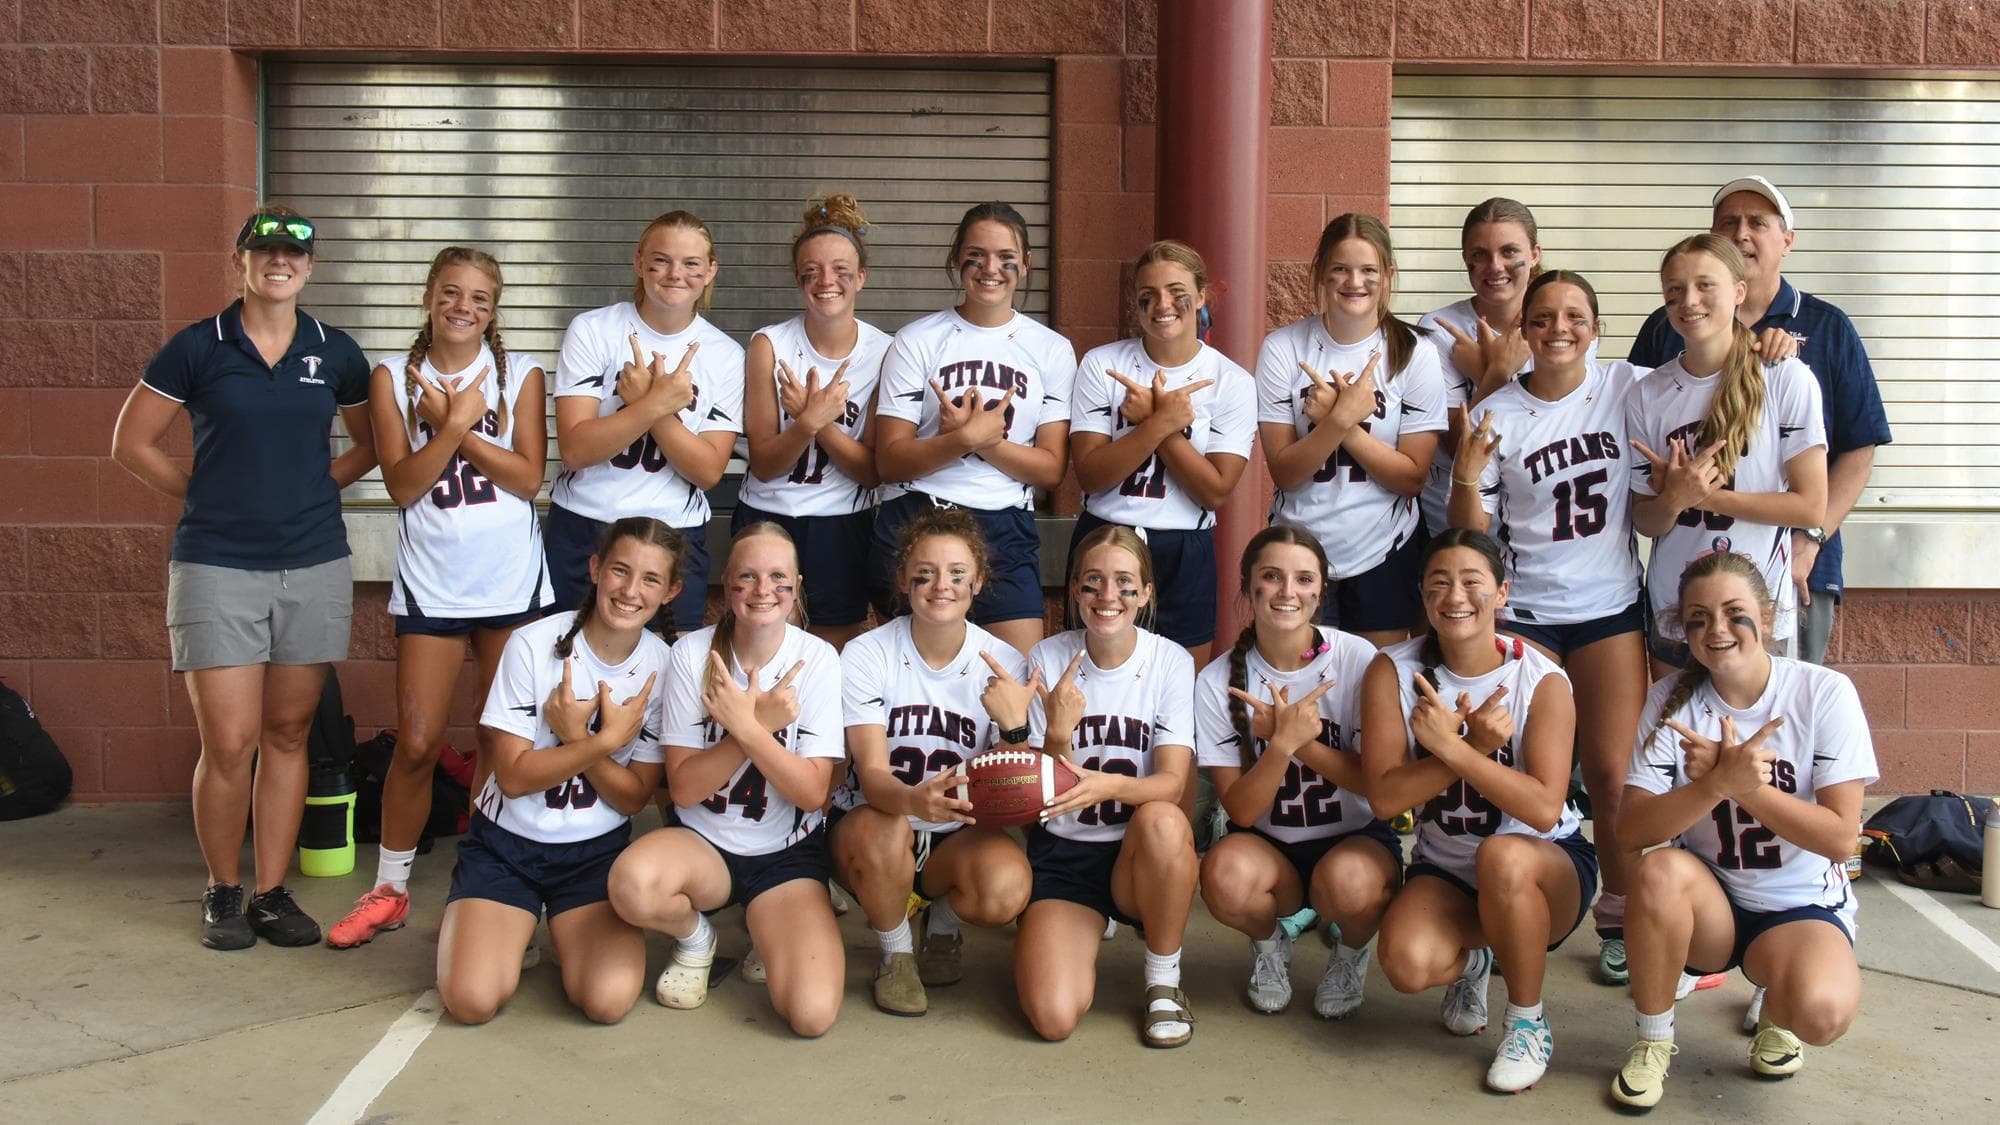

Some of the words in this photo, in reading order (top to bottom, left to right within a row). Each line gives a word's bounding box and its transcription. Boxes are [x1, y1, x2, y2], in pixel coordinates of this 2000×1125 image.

[939, 359, 1028, 400] TITANS
[1523, 431, 1620, 485] TITANS
[1552, 467, 1608, 542] 15
[886, 704, 977, 750] TITANS
[1270, 760, 1343, 828] 22
[1711, 798, 1782, 870] 12
